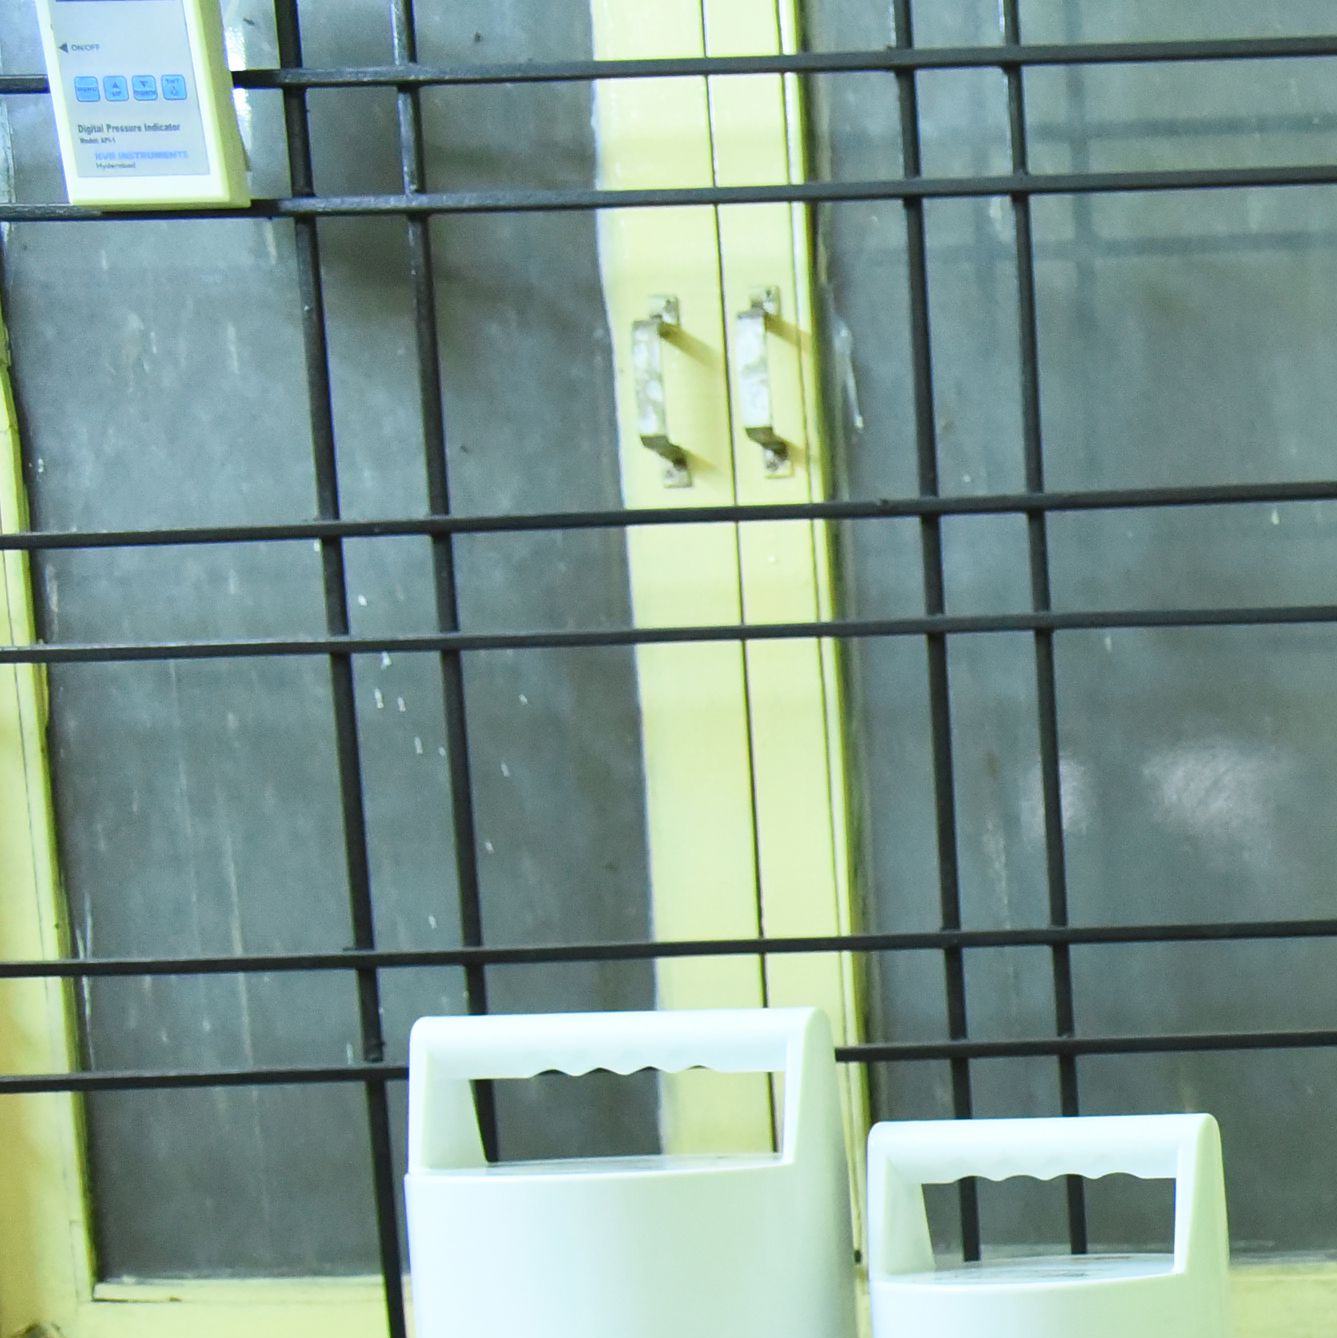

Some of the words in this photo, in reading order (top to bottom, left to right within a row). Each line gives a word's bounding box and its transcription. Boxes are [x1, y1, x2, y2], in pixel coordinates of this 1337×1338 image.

[71, 43, 100, 53] ON/OFF
[78, 124, 103, 135] Digital
[106, 123, 142, 133] Pressure
[144, 122, 180, 132] Indicator
